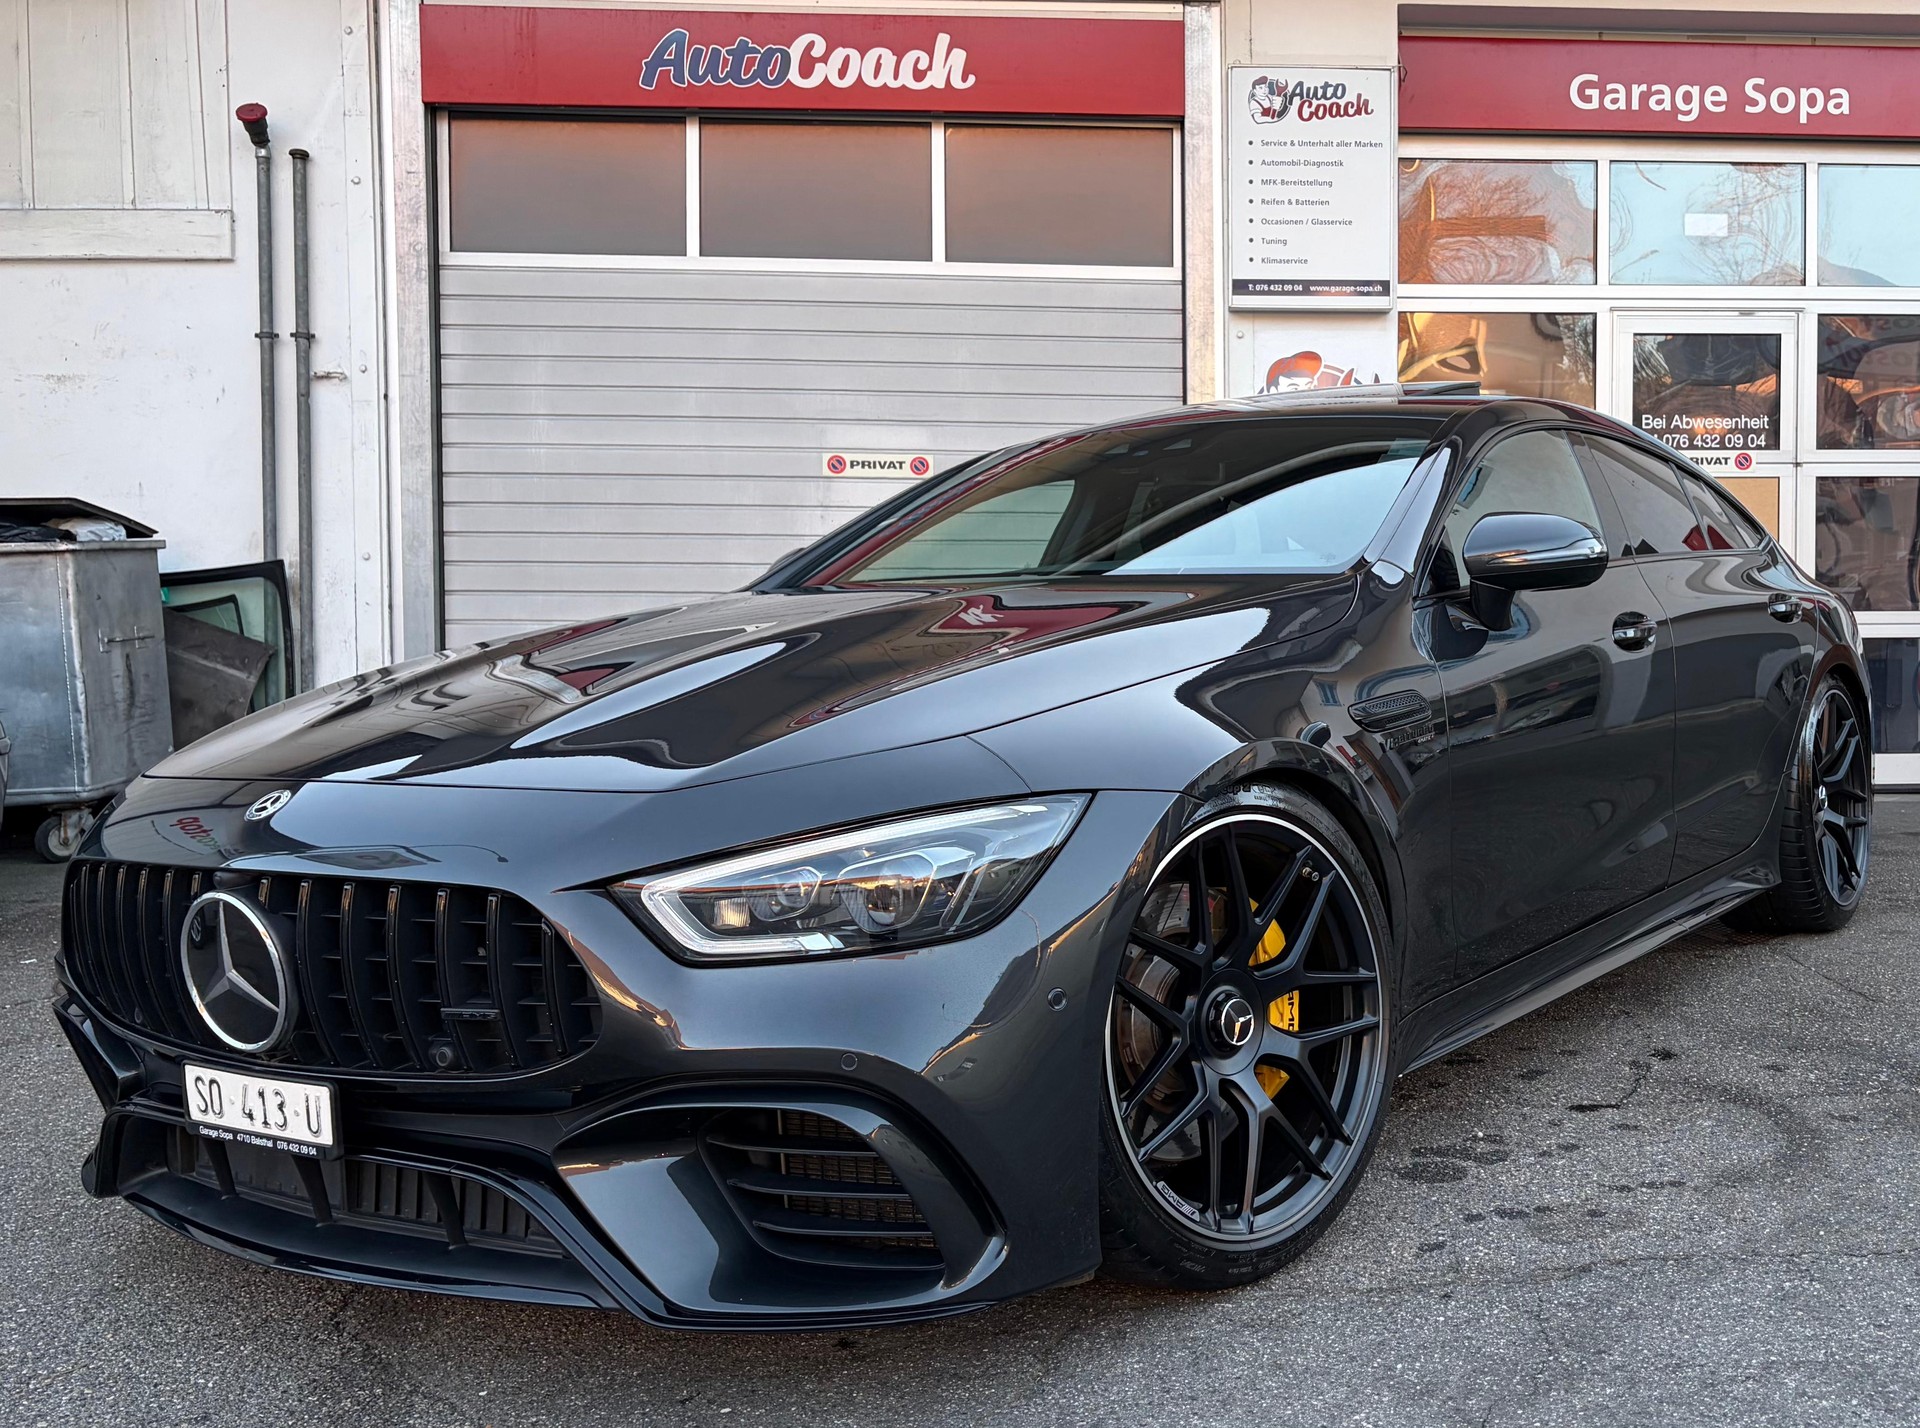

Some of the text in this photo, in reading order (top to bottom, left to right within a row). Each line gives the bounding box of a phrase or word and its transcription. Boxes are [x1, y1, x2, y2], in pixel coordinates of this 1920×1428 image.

[1288, 80, 1347, 102] Auto
[1569, 73, 1850, 124] Garage Sopa
[1297, 93, 1374, 122] Coach
[1260, 139, 1383, 149] Service & Unterhalt aller Marken
[1260, 159, 1344, 169] Automobil-Diagnostik
[1260, 178, 1333, 188] MFK-Bereitstellung
[1260, 198, 1330, 207] Reifen & Batterien
[1260, 218, 1304, 226] Occasionen
[1311, 217, 1353, 226] Glasservice
[1261, 237, 1288, 246] Tuning
[1261, 256, 1308, 265] Klimaservice
[1283, 284, 1293, 292] 09
[1293, 284, 1303, 292] 04
[1309, 284, 1383, 293] www.garage-sopa.ch
[1641, 414, 1769, 430] Bei Abwesenheit
[1662, 434, 1766, 448] 076 432 09 04
[849, 460, 906, 470] PRIVAT
[1689, 457, 1731, 466] RIVAT
[194, 1075, 322, 1137] SO 413 U
[199, 1125, 317, 1155] Garage Sopa 4710 Balsthal 076 432 09 04
